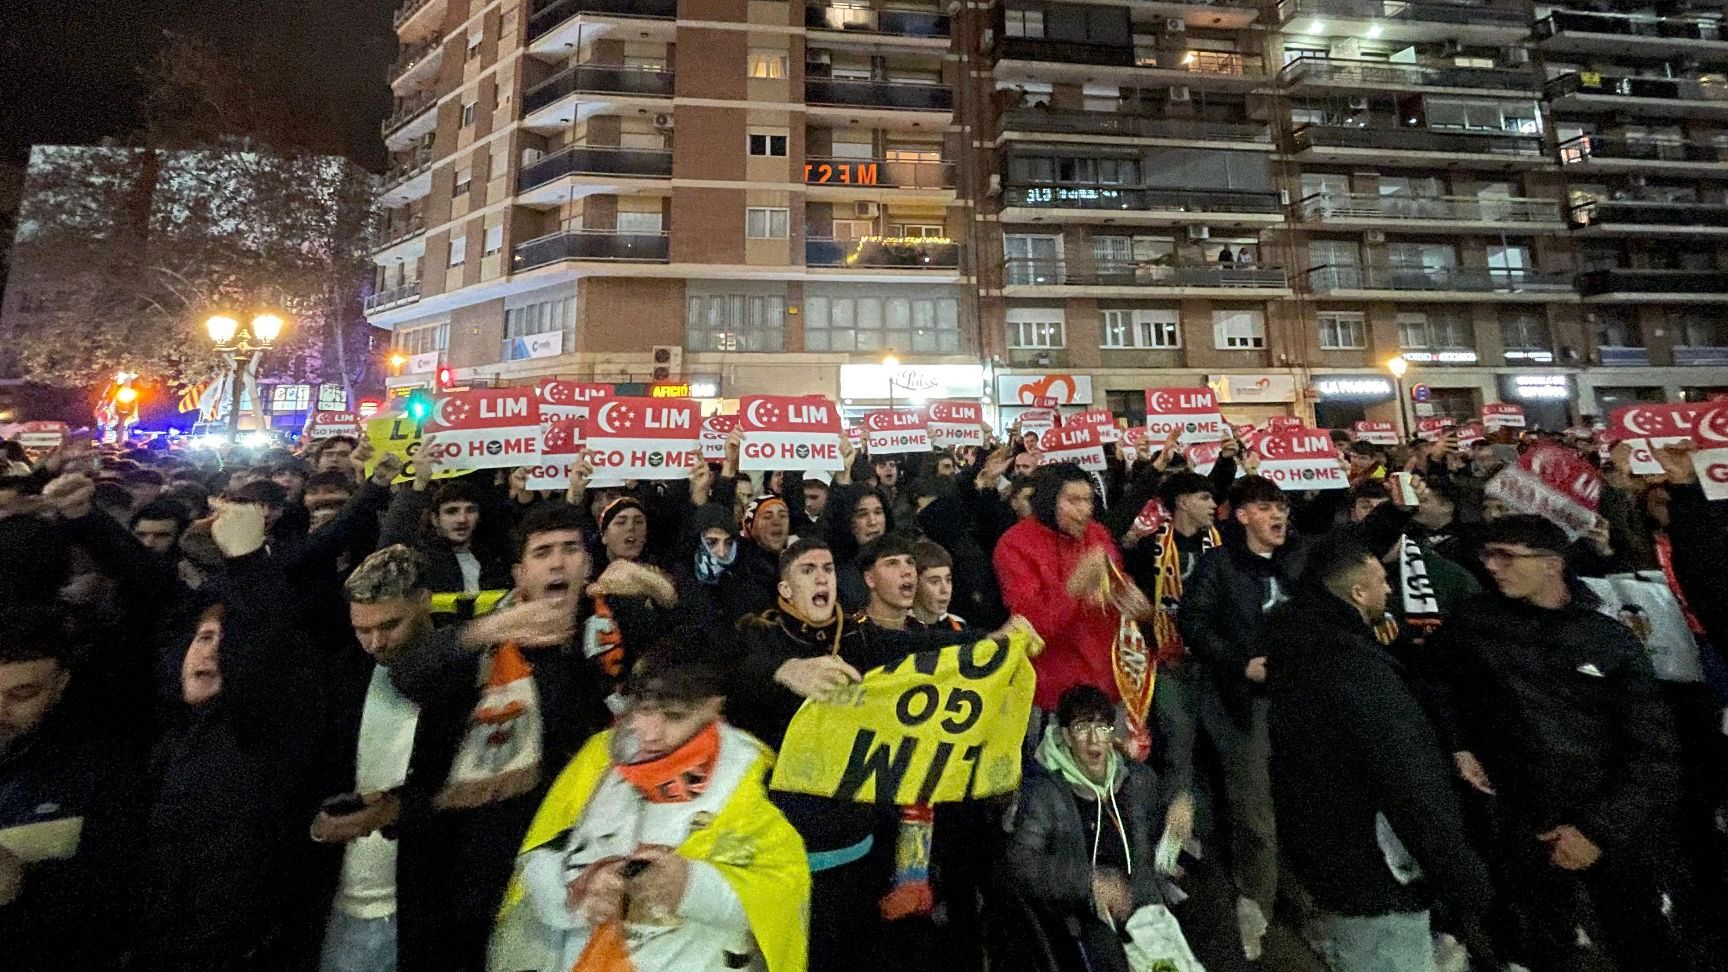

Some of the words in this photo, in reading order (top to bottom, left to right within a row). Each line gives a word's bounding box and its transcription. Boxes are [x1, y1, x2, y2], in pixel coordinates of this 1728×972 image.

[480, 397, 528, 418] LIM
[1180, 394, 1212, 408] LIM
[334, 413, 355, 422] LIM
[540, 412, 561, 423] GO
[645, 407, 690, 428] LIM
[788, 404, 828, 424] LIM
[893, 413, 920, 425] LIM
[951, 406, 975, 419] LIM
[1086, 413, 1106, 423] LIM
[390, 420, 423, 440] LI
[946, 428, 980, 439] HOME
[1150, 423, 1172, 433] GO
[869, 438, 887, 447] GO
[890, 435, 927, 446] HOME
[1061, 428, 1091, 445] LIM
[1292, 436, 1329, 453] LIM
[468, 437, 536, 457] HOME
[744, 443, 776, 459] GO
[780, 443, 838, 459] HOME
[590, 450, 625, 467] GO
[630, 450, 696, 467] HOME
[532, 465, 559, 478] GO
[1290, 467, 1341, 480] HOME
[1706, 463, 1728, 483] G
[896, 684, 983, 735] GO
[832, 727, 987, 805] LIM
